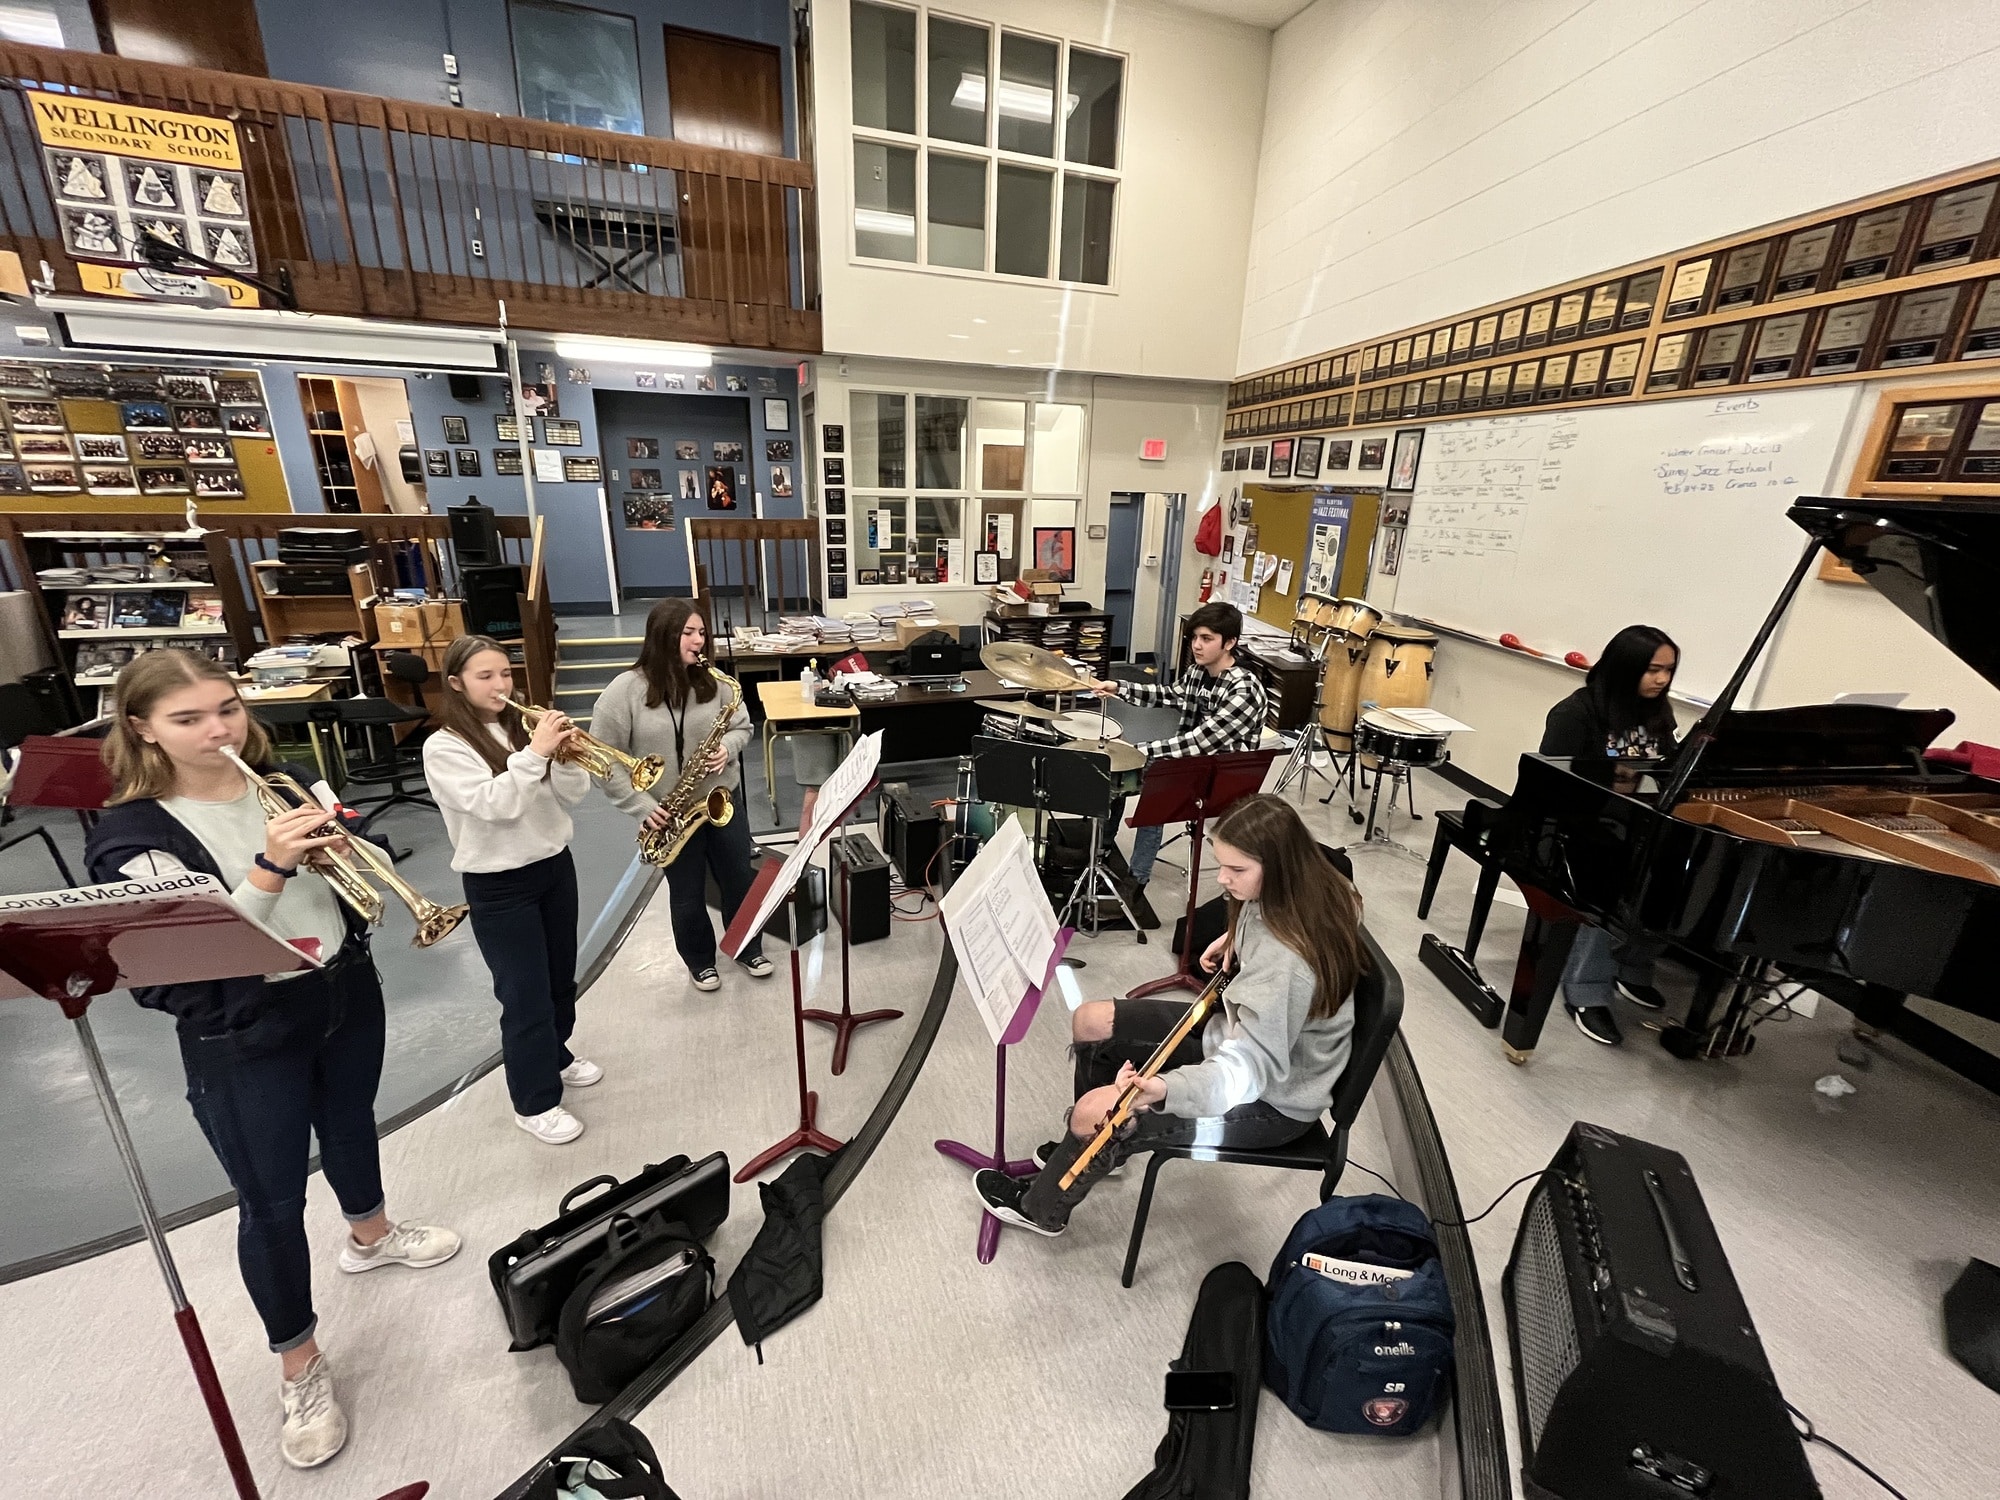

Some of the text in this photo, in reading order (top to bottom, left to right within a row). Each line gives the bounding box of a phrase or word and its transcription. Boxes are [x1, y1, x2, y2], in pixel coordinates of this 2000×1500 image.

[38, 102, 230, 145] WELLINGTON
[51, 127, 234, 161] SECONDARY SCHOOL
[1714, 399, 1759, 413] Events
[1742, 443, 1767, 455] Dec
[1693, 464, 1721, 477] Jazz
[1328, 507, 1349, 519] FESTIVAL
[59, 893, 84, 903] &
[80, 873, 210, 901] McQuade
[1324, 1262, 1357, 1280] Long
[1359, 1270, 1369, 1281] &
